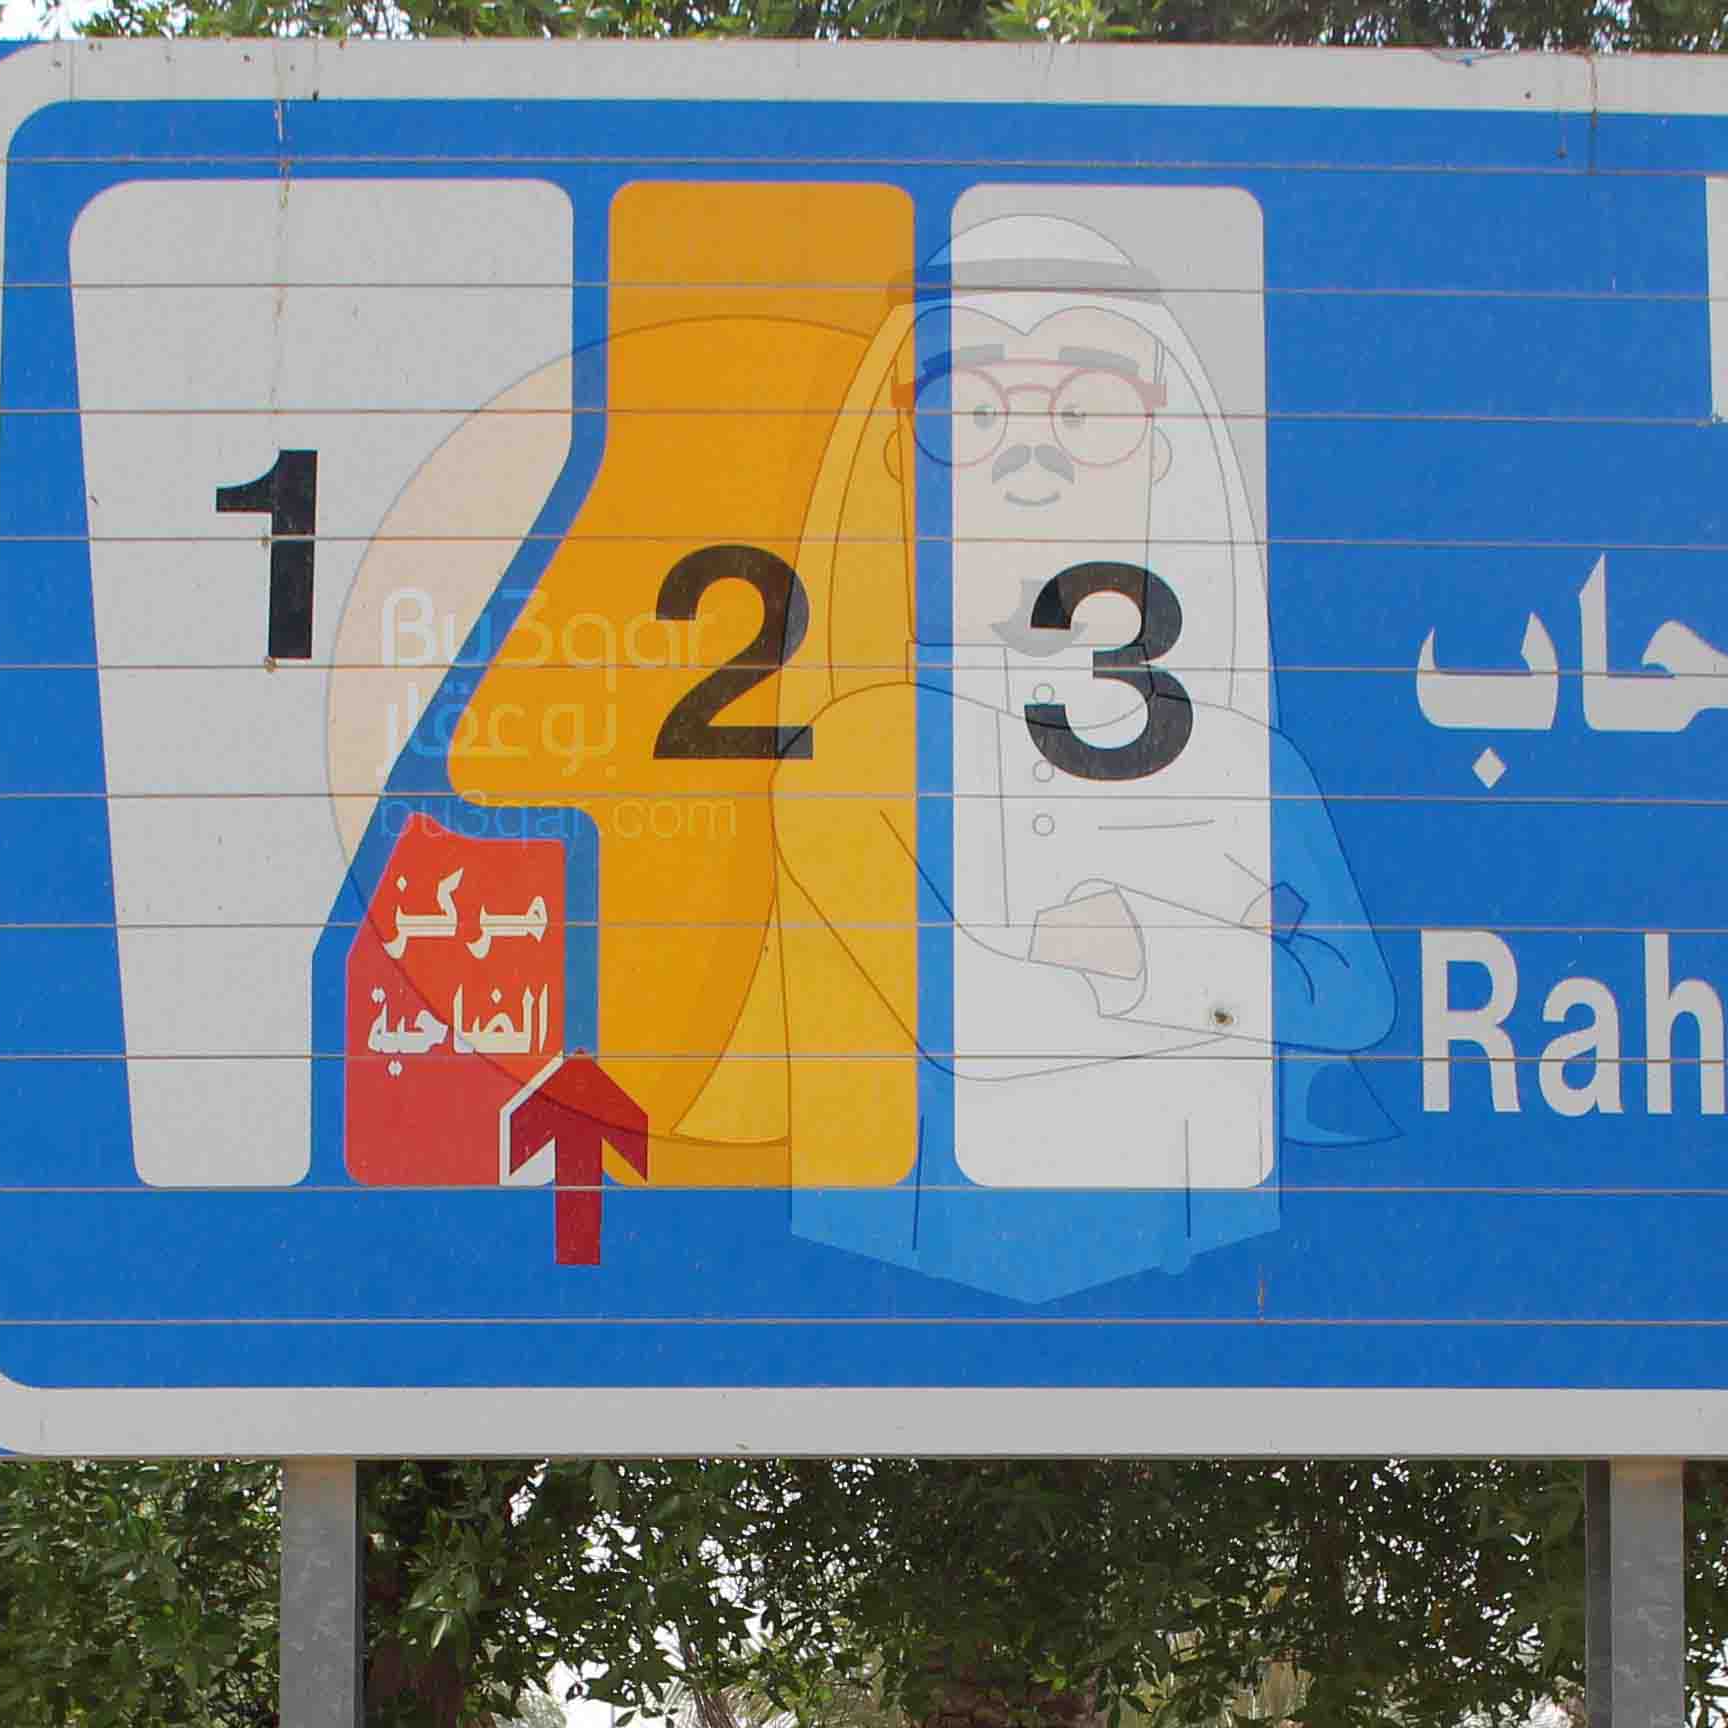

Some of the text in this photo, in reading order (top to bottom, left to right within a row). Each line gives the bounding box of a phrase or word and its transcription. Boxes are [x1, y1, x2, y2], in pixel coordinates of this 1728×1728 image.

[215, 449, 318, 659] 1
[653, 544, 812, 760] 2
[1023, 561, 1194, 782] 3
[383, 866, 548, 959] مركز
[367, 983, 549, 1077] الضاحية
